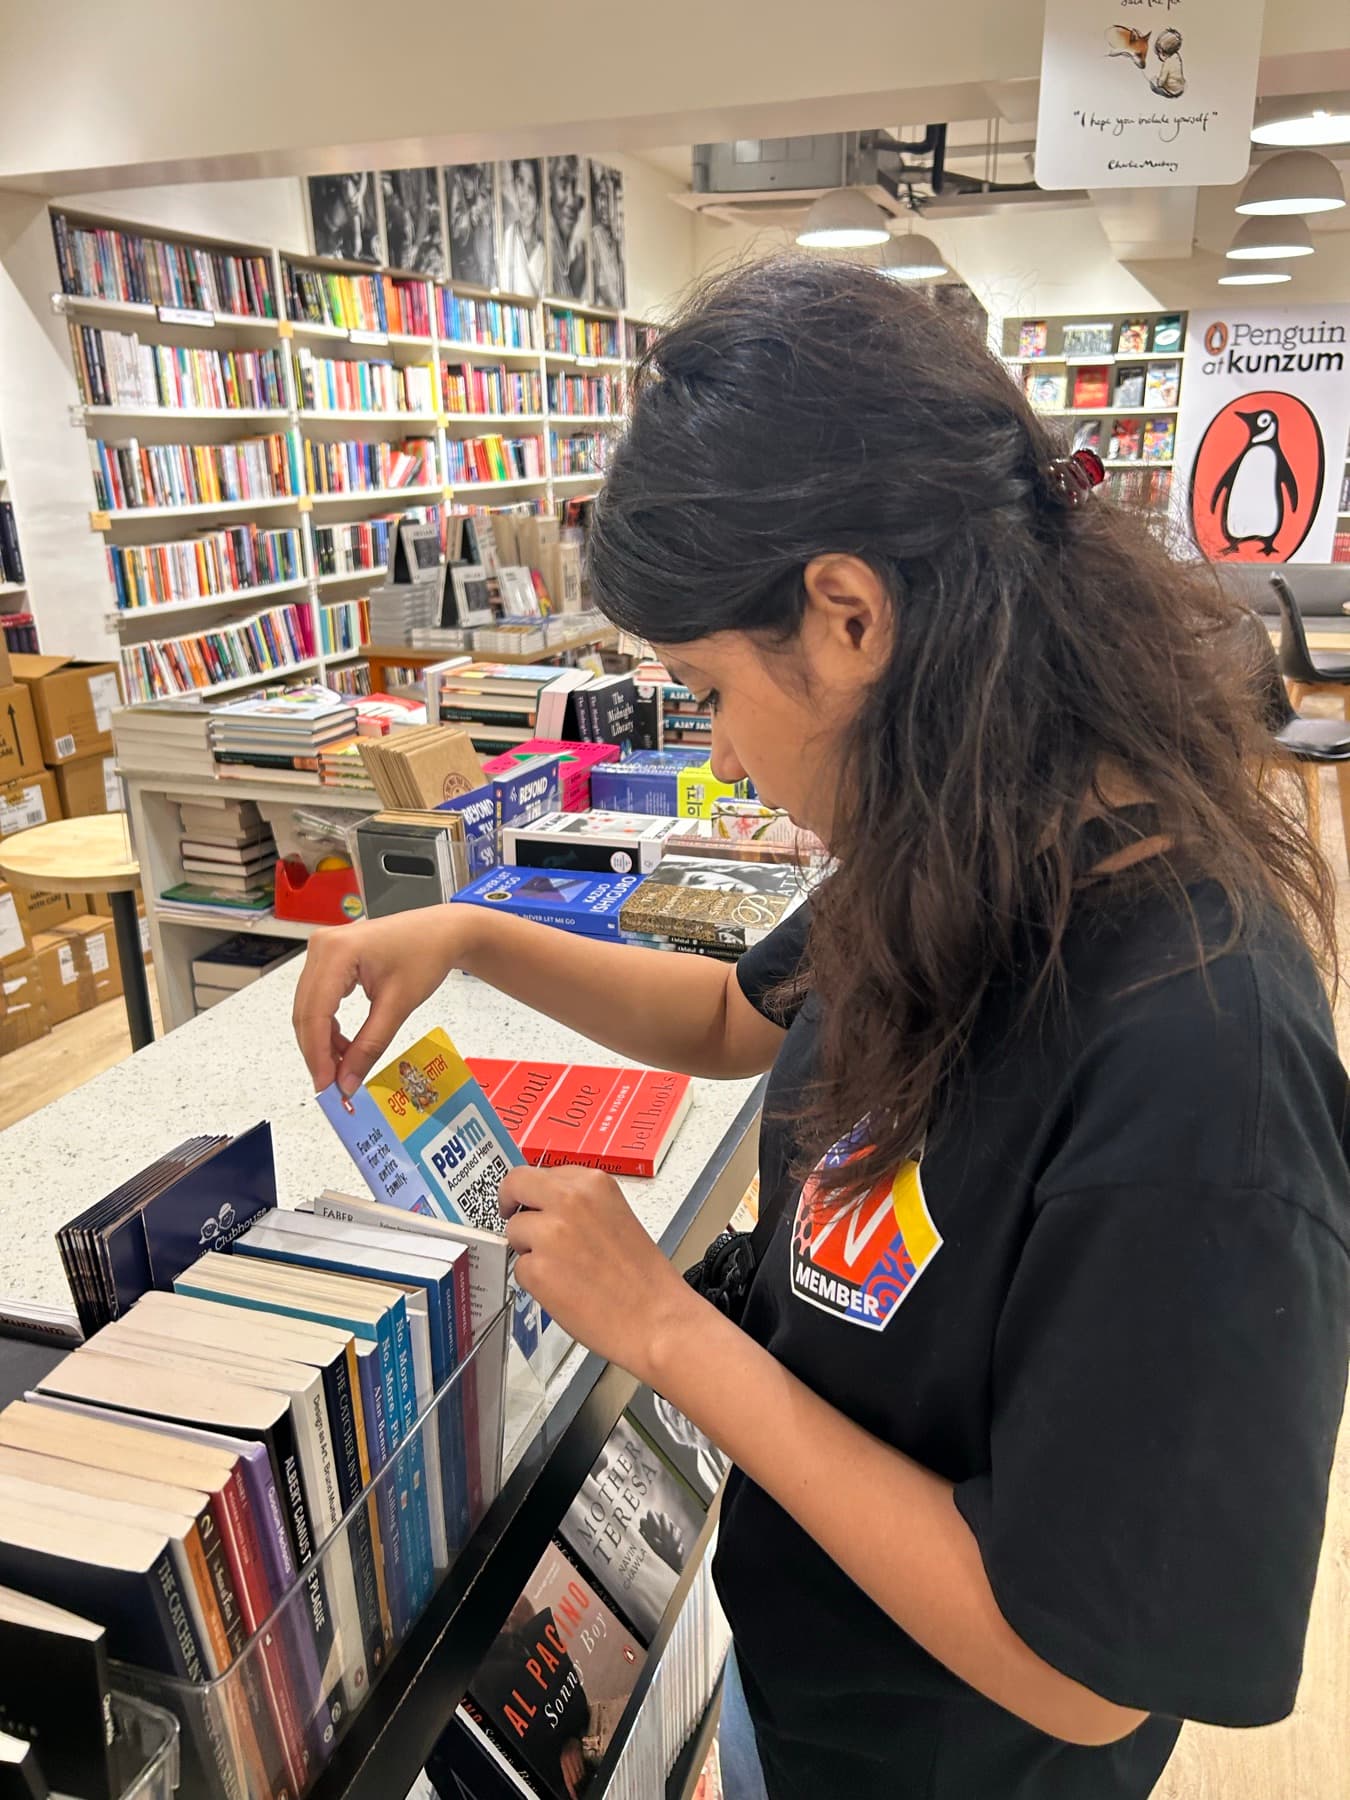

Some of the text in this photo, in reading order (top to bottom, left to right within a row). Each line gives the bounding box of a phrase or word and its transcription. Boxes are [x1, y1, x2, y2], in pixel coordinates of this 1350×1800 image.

[1230, 321, 1347, 351] Penguin
[1202, 349, 1344, 376] at kunzum
[607, 704, 634, 722] Midnight
[613, 691, 625, 704] The
[611, 721, 634, 737] Library
[520, 777, 548, 805] BEYOND
[463, 798, 494, 826] BEYOND
[589, 876, 637, 913] ISHIGURO
[543, 915, 554, 923] LET
[554, 916, 565, 924] ME
[423, 1054, 449, 1081] लाभ
[388, 1088, 410, 1117] शुभ
[496, 1072, 552, 1132] about
[548, 1085, 600, 1128] love
[600, 1085, 630, 1133] NEW VISIONS
[621, 1076, 679, 1151] bell hooks
[357, 1141, 372, 1155] Fun
[367, 1144, 390, 1169] for the
[447, 1140, 494, 1191] Accepted Here
[215, 1207, 267, 1251] Clubhouse
[796, 1263, 880, 1318] MEMBER
[395, 1318, 405, 1348] No.
[381, 1337, 391, 1367] No.
[334, 1361, 347, 1384] THE
[398, 1350, 411, 1397] More.
[373, 1385, 383, 1418] Alan
[384, 1370, 398, 1418] More.
[336, 1386, 357, 1457] CATCHER
[314, 1393, 325, 1431] Design
[324, 1462, 334, 1488] Bruno
[347, 1459, 357, 1475] IN
[576, 1440, 643, 1548] MOTHER
[593, 1461, 657, 1566] TERESA
[284, 1455, 302, 1507] ALBERT
[294, 1505, 311, 1555] CAMUS
[309, 1581, 326, 1632] PLAGUE
[618, 1543, 638, 1578] NAVIN
[623, 1548, 647, 1592] CHAWLA
[158, 1556, 177, 1596] THE
[168, 1590, 197, 1662] CATCHER
[503, 1694, 537, 1737] AL
[526, 1581, 590, 1690] PACINO
[543, 1612, 612, 1729] Sonny Boy
